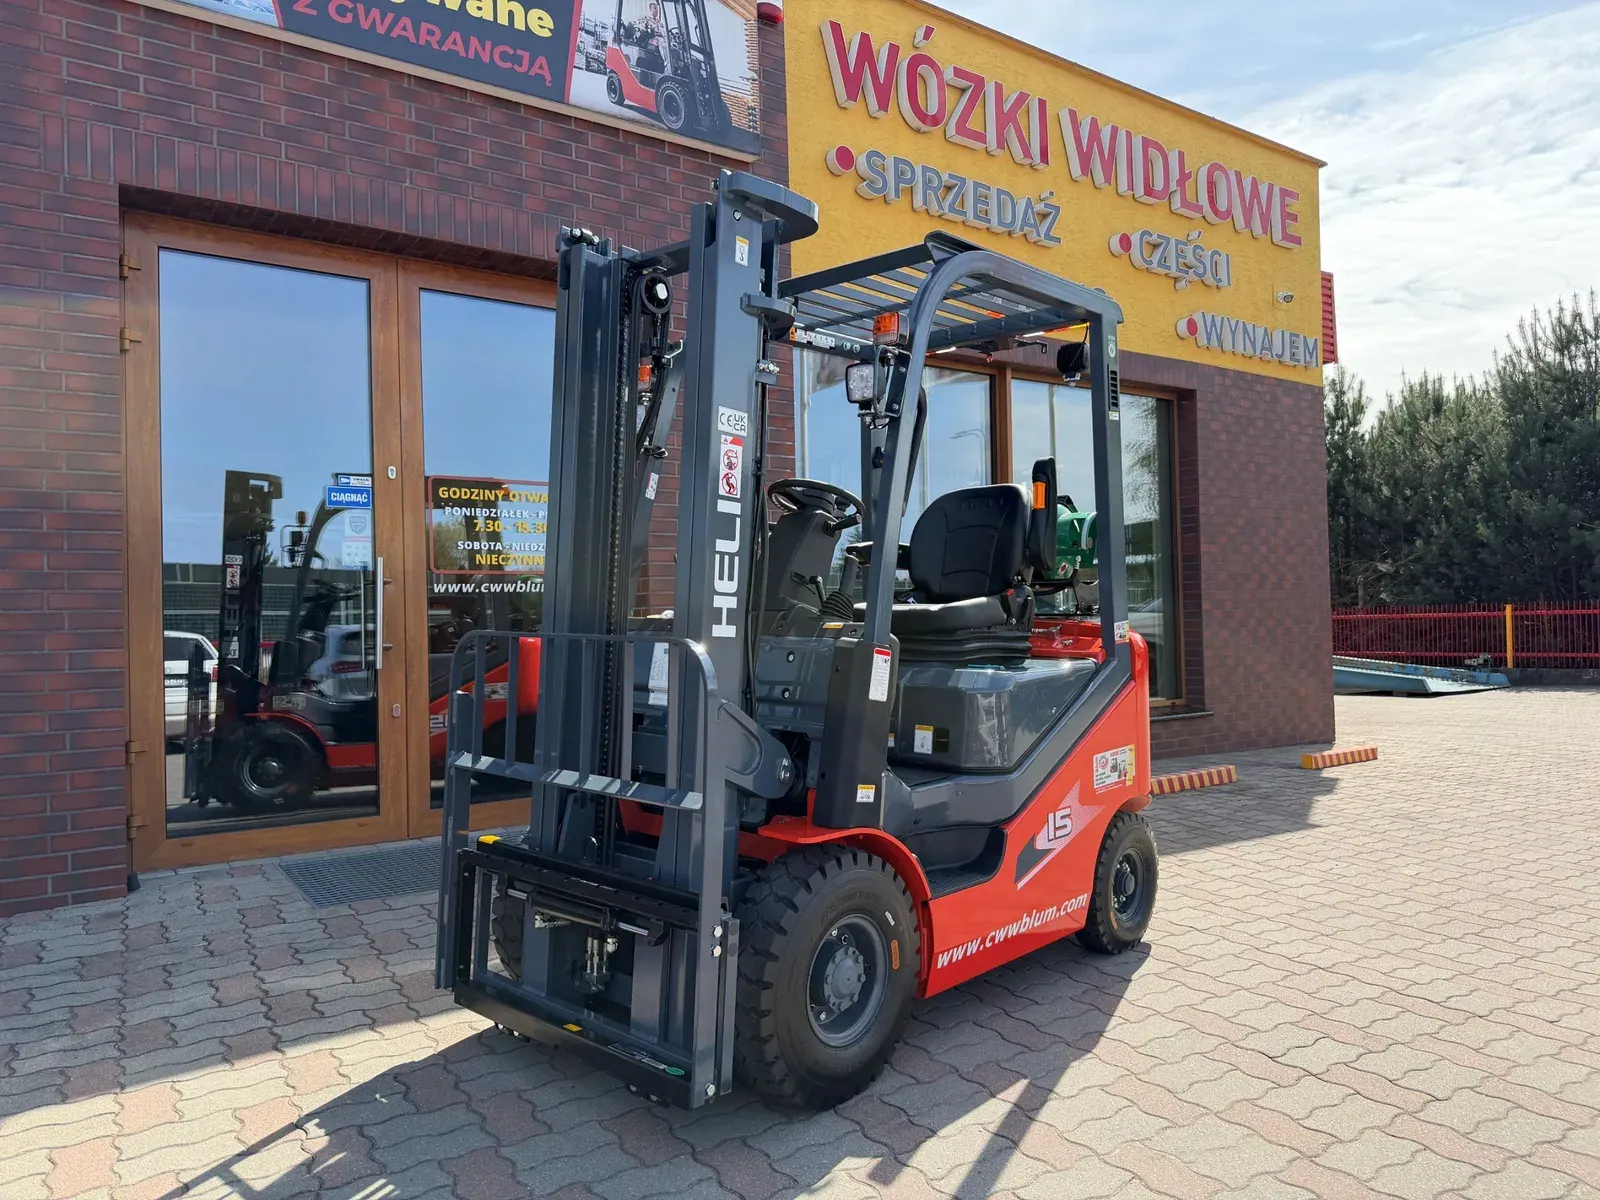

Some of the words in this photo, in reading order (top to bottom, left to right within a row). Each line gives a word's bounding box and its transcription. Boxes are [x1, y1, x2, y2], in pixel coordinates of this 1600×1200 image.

[327, 0, 552, 87] GWARANCJĄ
[820, 19, 1050, 170] WÓZKI
[1058, 107, 1303, 248] WIDŁOWE
[856, 149, 1063, 248] SPRZEDAŻ
[1130, 229, 1231, 290] CZĘŚCI
[1193, 311, 1320, 368] WYNAJEM
[331, 491, 368, 504] CIĄGNĄĆ
[438, 487, 505, 501] GODZINY
[445, 506, 530, 519] PONIEDZIAŁEK
[457, 541, 504, 551] SOBOTA
[473, 519, 503, 532] 7.30
[712, 499, 742, 638] HELI
[1046, 806, 1073, 841] 15
[936, 893, 1088, 969] www.cwwblum.com
